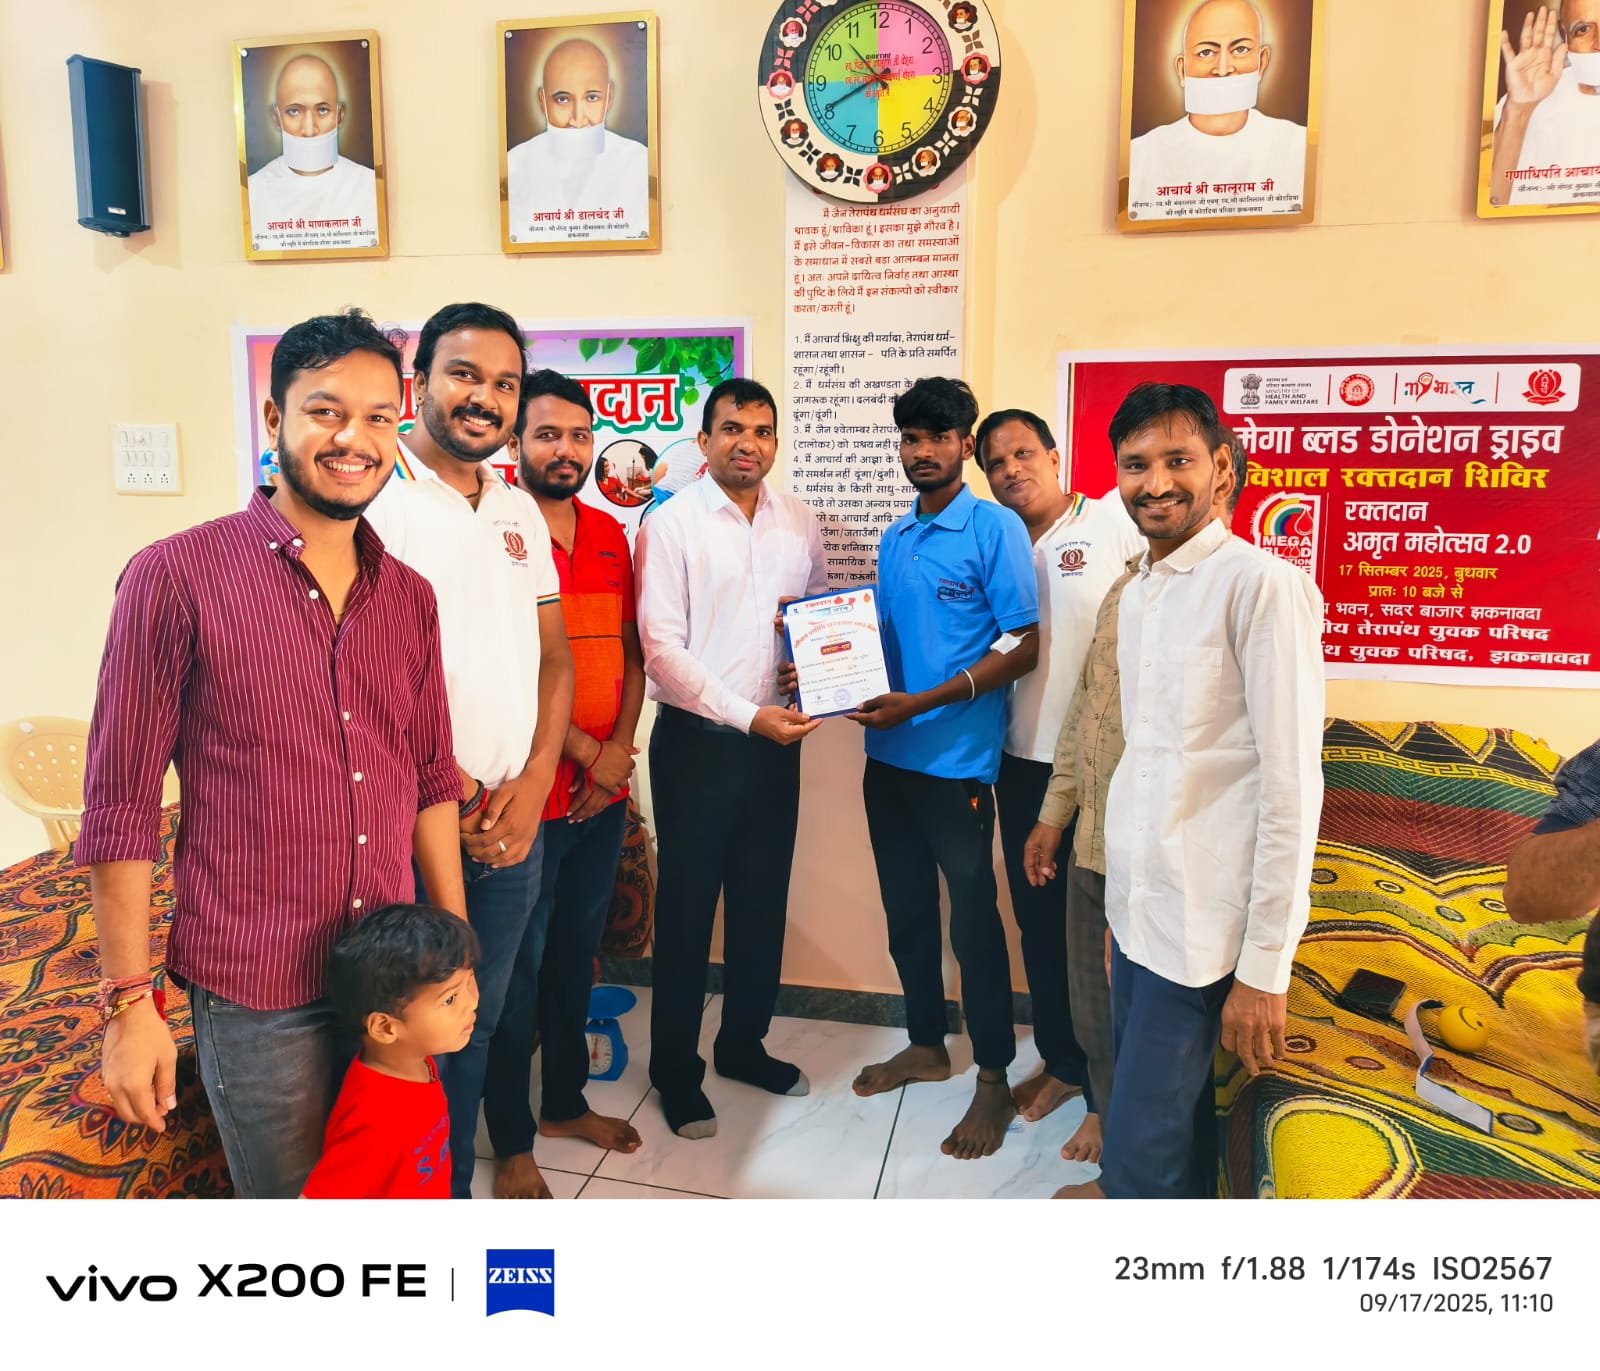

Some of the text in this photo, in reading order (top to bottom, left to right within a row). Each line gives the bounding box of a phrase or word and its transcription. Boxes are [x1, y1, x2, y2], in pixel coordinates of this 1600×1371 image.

[870, 12, 890, 28] 12
[905, 18, 912, 34] 1
[845, 22, 859, 38] 11
[825, 44, 842, 61] 10
[922, 37, 933, 54] 2
[817, 75, 826, 91] 9
[932, 67, 942, 84] 3
[825, 104, 835, 119] 8
[923, 97, 936, 113] 4
[846, 125, 856, 141] 7
[874, 130, 884, 146] 6
[902, 122, 912, 139] 5
[1505, 164, 1561, 180] गणाधिपति
[1156, 178, 1274, 196] आचार्य श्री कालूराम जी
[533, 207, 624, 221] आचार्य श्री डालचंद जी
[832, 202, 960, 219] जैन तेरापंथ धर्मसंघ का अनुयायी
[267, 218, 293, 230] आचार्य
[296, 218, 304, 228] श्री
[352, 216, 362, 228] जी
[794, 220, 946, 235] श्रावक इसका मुझे गौरव
[803, 239, 816, 252] इसे
[883, 240, 894, 249] का
[898, 239, 914, 249] तथा
[918, 234, 959, 248] समस्याओं
[794, 256, 802, 268] के
[805, 257, 838, 266] समाधान
[851, 253, 872, 265] सबसे
[893, 254, 929, 264] आलम्बन
[932, 253, 958, 263] मानता
[828, 269, 848, 282] अपने
[852, 269, 881, 281] दायित्व
[885, 267, 909, 281] निर्वाह
[912, 270, 928, 279] तथा
[931, 269, 958, 279] आस्था
[794, 286, 804, 298] की
[807, 286, 825, 300] पुष्टि
[828, 286, 835, 297] के
[838, 285, 854, 297] लिये
[866, 288, 878, 298] इन
[914, 284, 925, 295] को
[928, 282, 958, 295] स्वीकार
[812, 331, 840, 344] आचार्य
[842, 331, 861, 346] भिक्षु
[863, 331, 873, 343] की
[906, 331, 934, 343] तेरापंथ
[794, 345, 956, 360] शासन तथा शासन पति के प्रति समर्पित
[818, 378, 845, 389] धर्मसंघ
[849, 377, 860, 389] की
[864, 380, 900, 389] अखण्डता
[904, 377, 913, 389] के
[793, 392, 886, 405] जागरूक दलबंदी
[816, 423, 831, 434] जैन
[834, 422, 869, 434] श्वेताम्बर
[838, 438, 848, 449] को
[853, 440, 873, 450] प्रश्रय
[1233, 416, 1564, 460] मेगा ब्लड डोनेशन ड्राइव
[815, 453, 842, 464] आचार्य
[846, 452, 856, 463] की
[860, 454, 882, 464] आज्ञा
[886, 453, 894, 463] के
[793, 467, 833, 479] को समर्थन
[1244, 461, 1549, 488] विशाल रक्तदान शिविर
[806, 482, 833, 493] धर्मसंघ
[838, 483, 846, 493] के
[851, 482, 872, 493] किसी
[826, 497, 835, 508] तो
[838, 499, 862, 508] उसका
[865, 499, 891, 509] अन्यत्र
[1345, 501, 1429, 521] रक्तदान
[828, 511, 892, 523] या आचार्य आदि
[842, 541, 872, 552] शनिवार
[1263, 536, 1312, 546] MEGA
[1343, 525, 1531, 560] अमृत महोत्सव 2.0
[828, 556, 865, 567] सामायिक
[1339, 562, 1498, 582] 17 सितम्बर 2025, बुधवार
[1403, 586, 1417, 597] 10
[1422, 583, 1445, 598] बजे
[1451, 584, 1464, 598] से
[1336, 603, 1374, 618] भवन,
[1380, 604, 1414, 617] सदर
[1419, 605, 1465, 619] बाजार
[1470, 606, 1542, 621] झकनावदा
[1357, 619, 1420, 637] तेरापंथ
[1429, 625, 1481, 642] युवक
[1488, 624, 1551, 641] परिषद
[1349, 645, 1400, 662] युवक
[1408, 644, 1474, 661] परिषद,
[1489, 650, 1591, 666] झकनावदा
